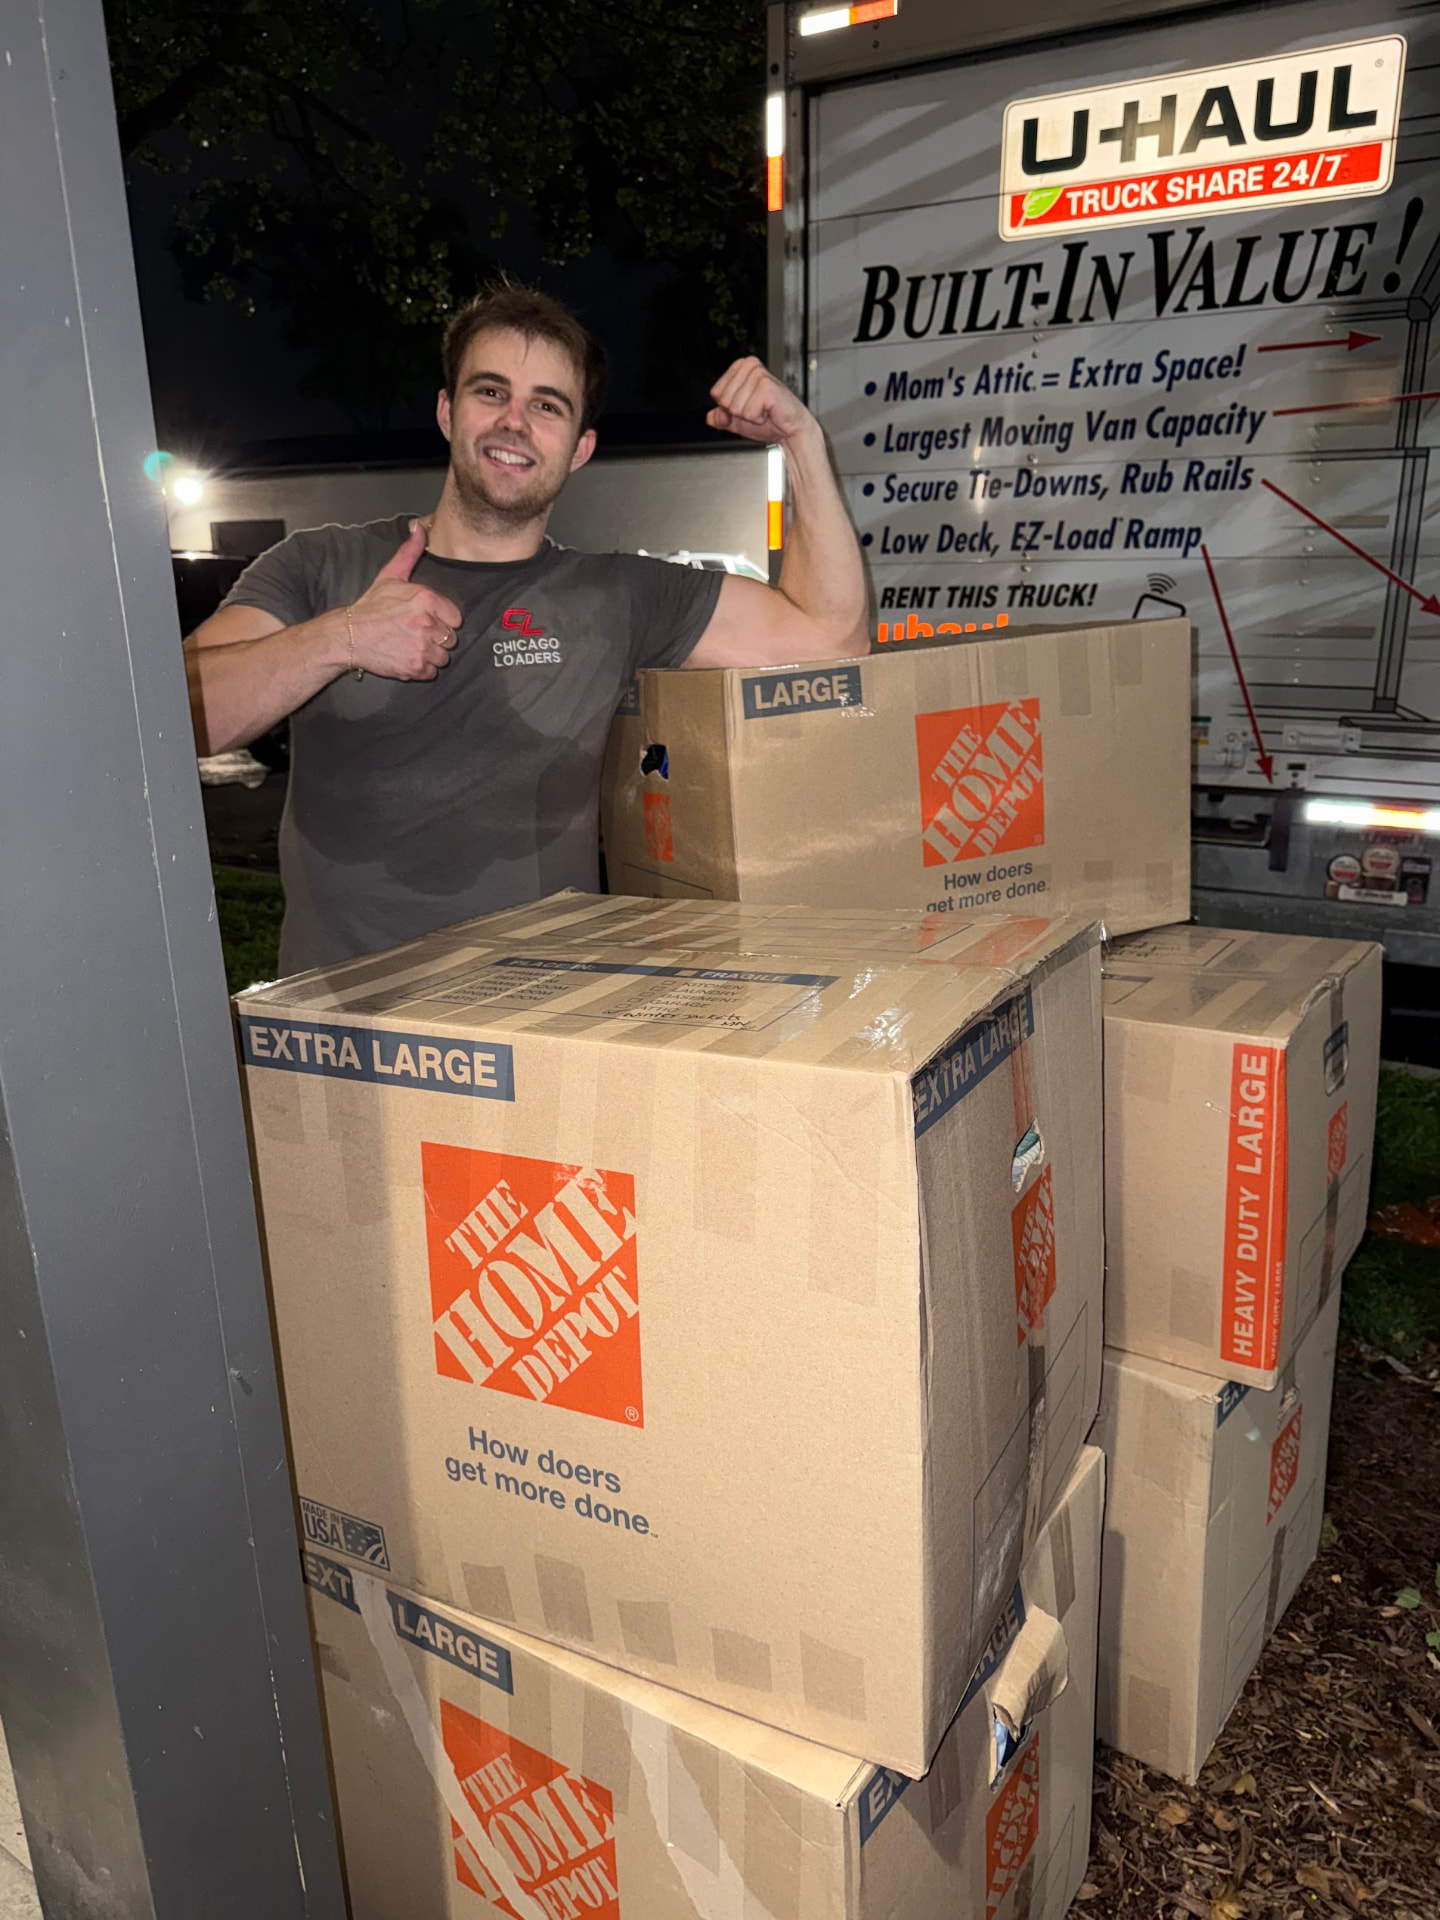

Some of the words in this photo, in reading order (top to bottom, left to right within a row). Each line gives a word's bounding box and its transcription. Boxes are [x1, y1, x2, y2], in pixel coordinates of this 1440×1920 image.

[1021, 64, 1379, 176] U-HAUL
[1066, 180, 1159, 216] TRUCK
[1166, 165, 1264, 202] SHARE
[1271, 153, 1343, 190] 24/7
[883, 366, 965, 402] Mom's
[1068, 357, 1142, 389] Extra
[1152, 343, 1248, 393] Space!
[883, 422, 971, 460] Largest
[979, 414, 1074, 453] Moving
[1086, 410, 1137, 443] Van
[1145, 402, 1268, 448] Capacity
[883, 473, 958, 503] Secure
[968, 467, 1109, 501] Tie-Downs,
[1119, 458, 1173, 494] Rub
[1182, 456, 1255, 492] Rails
[880, 525, 930, 556] Low
[936, 519, 1001, 558] Deck,
[1010, 517, 1118, 552] EZ-Load
[1123, 518, 1203, 558] Ramp
[502, 608, 544, 636] CL
[880, 586, 941, 609] RENT
[946, 584, 999, 609] THIS
[1006, 583, 1098, 608] TRUCK!
[492, 637, 560, 654] CHICAGO
[493, 651, 562, 667] LOADERS
[754, 674, 849, 710] LARGE
[922, 700, 1042, 863] HOME
[931, 723, 983, 788] THE
[972, 755, 1044, 857] DEPOT
[926, 896, 954, 913] get
[958, 889, 1001, 910] more
[944, 870, 982, 891] How
[986, 862, 1033, 882] doers
[649, 1000, 713, 1009] GARAGE
[659, 994, 741, 1003] BASEMENT
[671, 988, 738, 997] LAUNDRY
[681, 981, 745, 990] KITCHEN
[699, 971, 789, 983] FRAGILE
[639, 1005, 680, 1013] ATTIC
[249, 1024, 363, 1071] EXTRA
[372, 1037, 499, 1088] LARGE
[914, 1042, 978, 1123] EXTRA
[979, 993, 1029, 1067] LARGE
[1236, 1053, 1267, 1175] LARGE
[444, 1179, 532, 1272] THE
[1236, 1186, 1260, 1262] DUTY
[432, 1164, 638, 1387] HOME
[510, 1265, 640, 1402] DEPOT
[1232, 1269, 1256, 1358] HEAVY
[445, 1457, 488, 1486] get
[495, 1471, 567, 1510] more
[468, 1426, 530, 1466] How
[537, 1449, 622, 1494] doers
[302, 1501, 329, 1521] MADE
[330, 1511, 341, 1525] IN
[304, 1514, 345, 1549] USA
[396, 1602, 501, 1680] LARGE
[461, 1752, 528, 1813] THE
